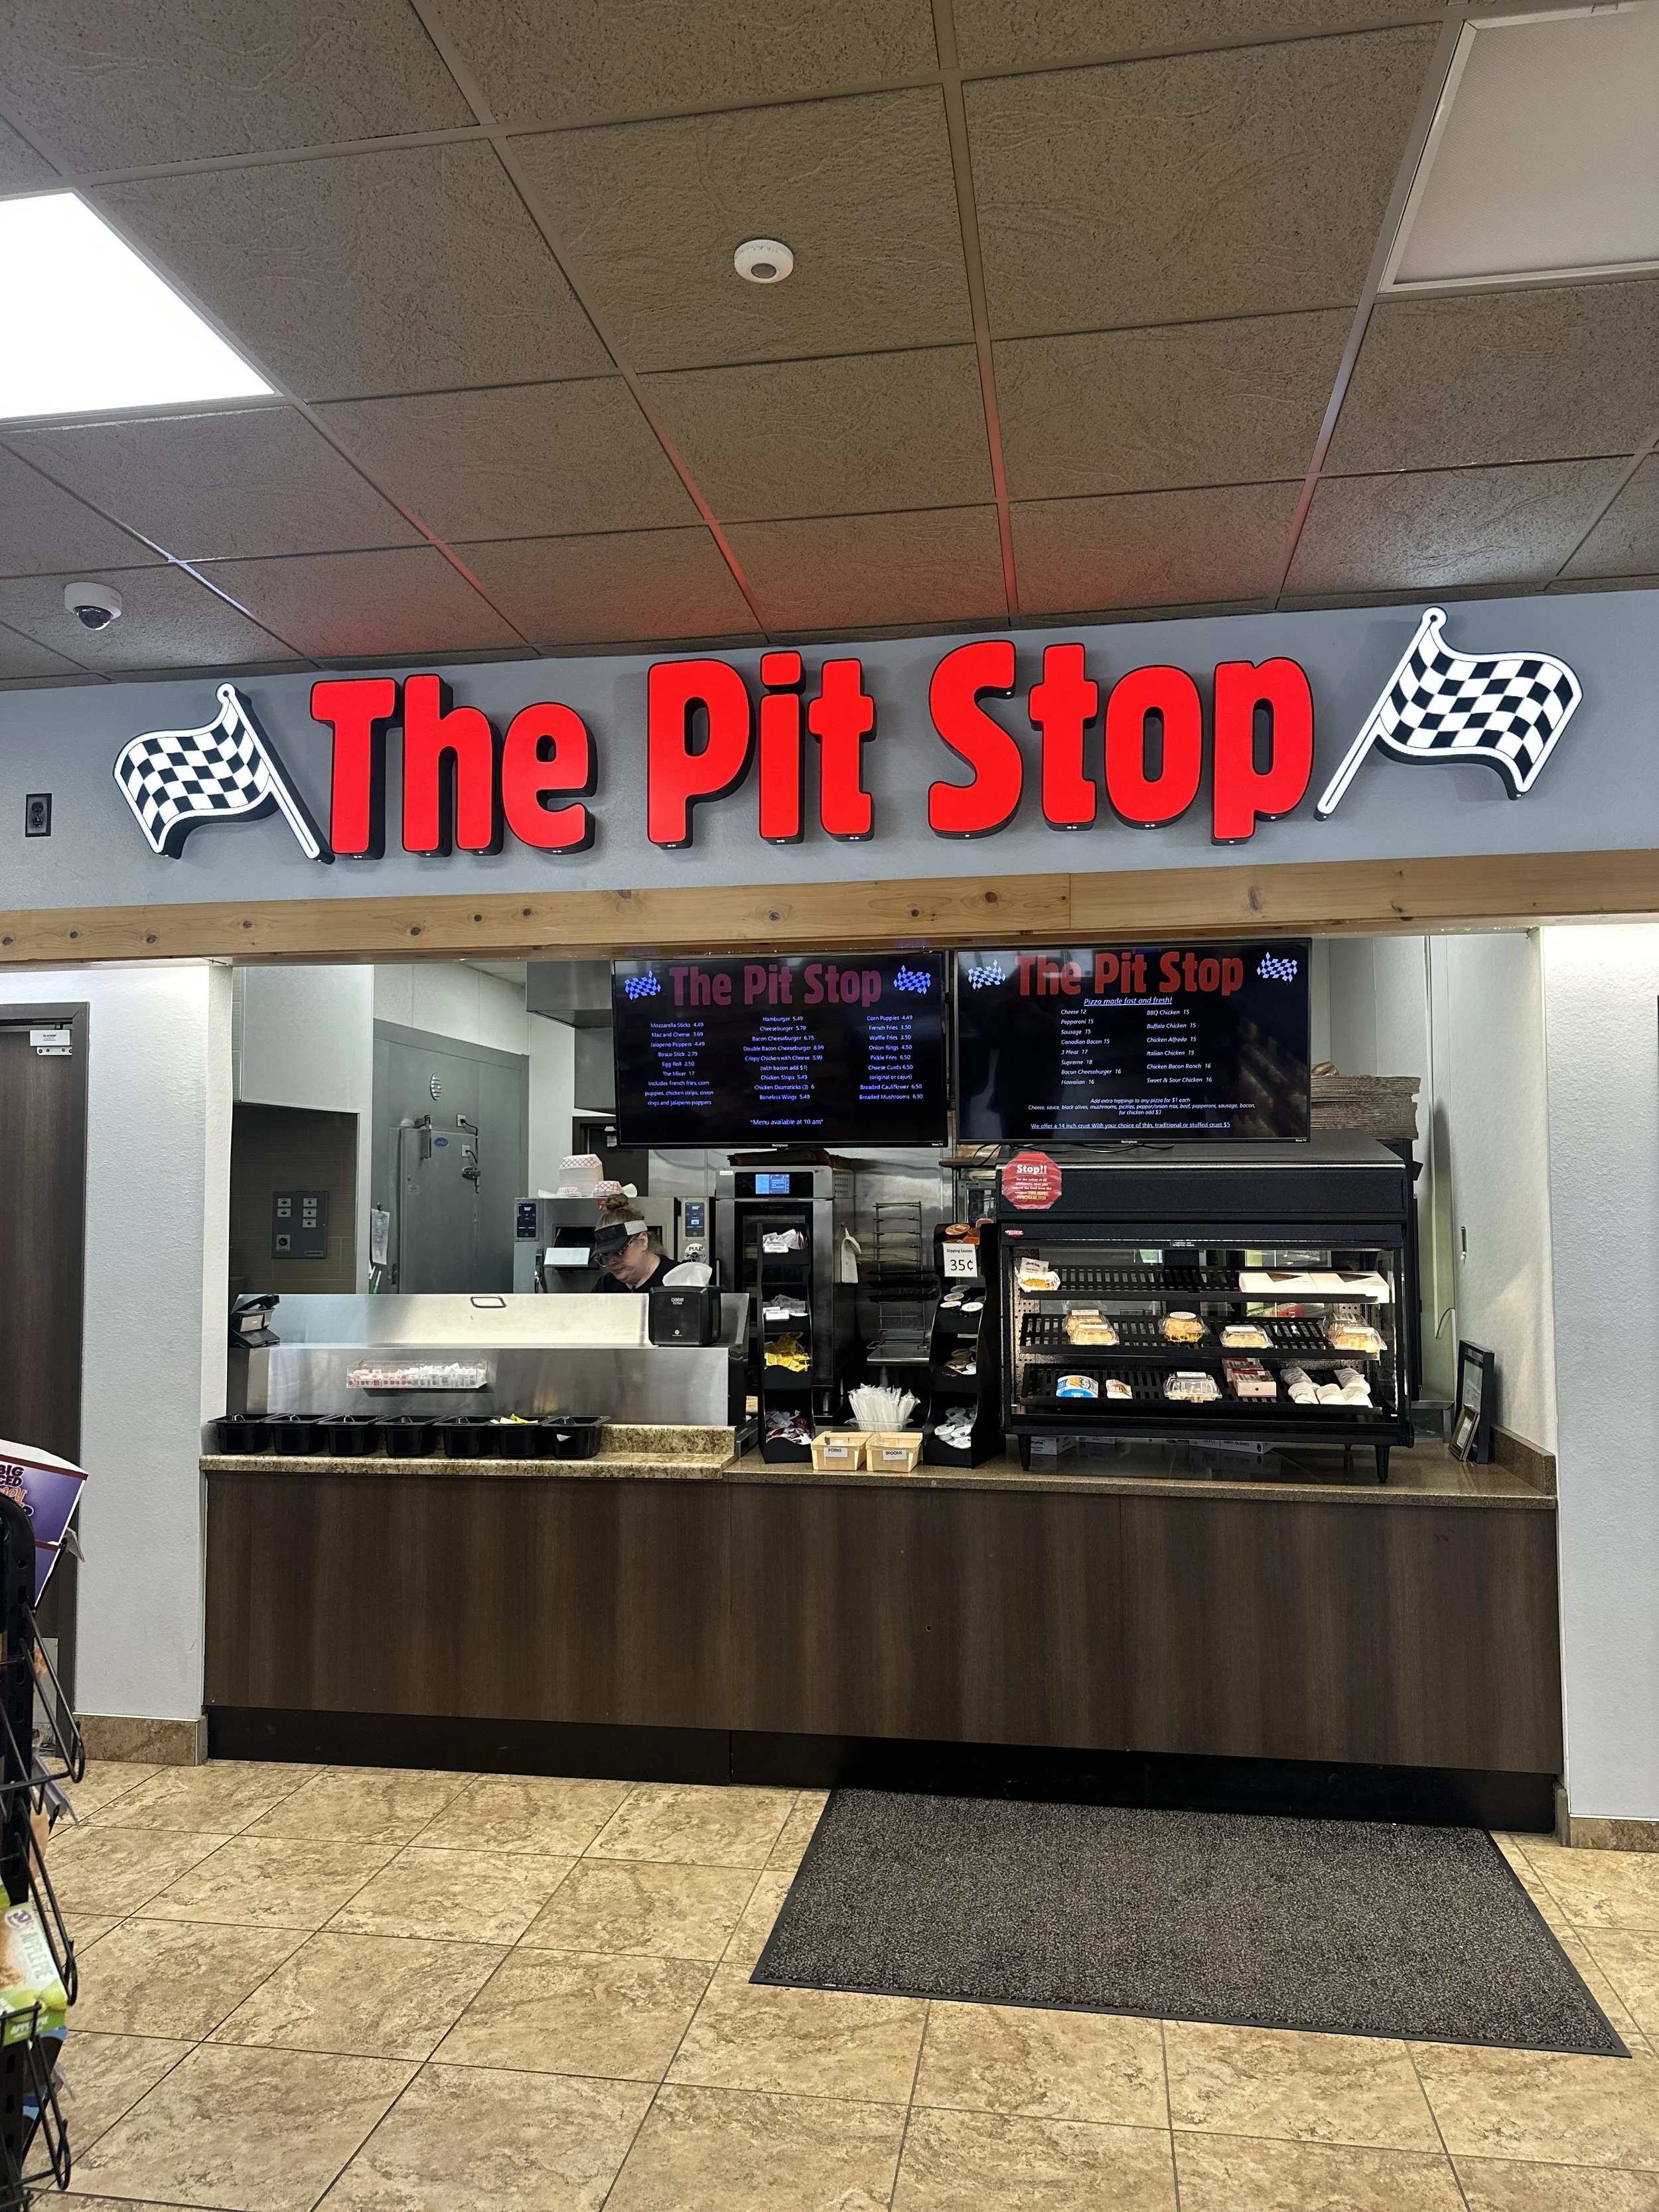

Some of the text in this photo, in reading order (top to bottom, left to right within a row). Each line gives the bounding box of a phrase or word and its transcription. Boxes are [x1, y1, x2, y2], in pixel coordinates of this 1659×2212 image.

[309, 640, 1314, 856] The Pit Stop
[1015, 951, 1244, 995] The Pit Stop
[668, 964, 881, 1007] The Pit Stop
[1084, 997, 1102, 1006] Pizza
[1103, 997, 1122, 1006] made
[1123, 997, 1137, 1006] fast
[1152, 997, 1173, 1005] fresh!
[1017, 1165, 1047, 1175] Stop!!
[950, 1260, 974, 1271] 35¢
[0, 1465, 24, 1477] BIG
